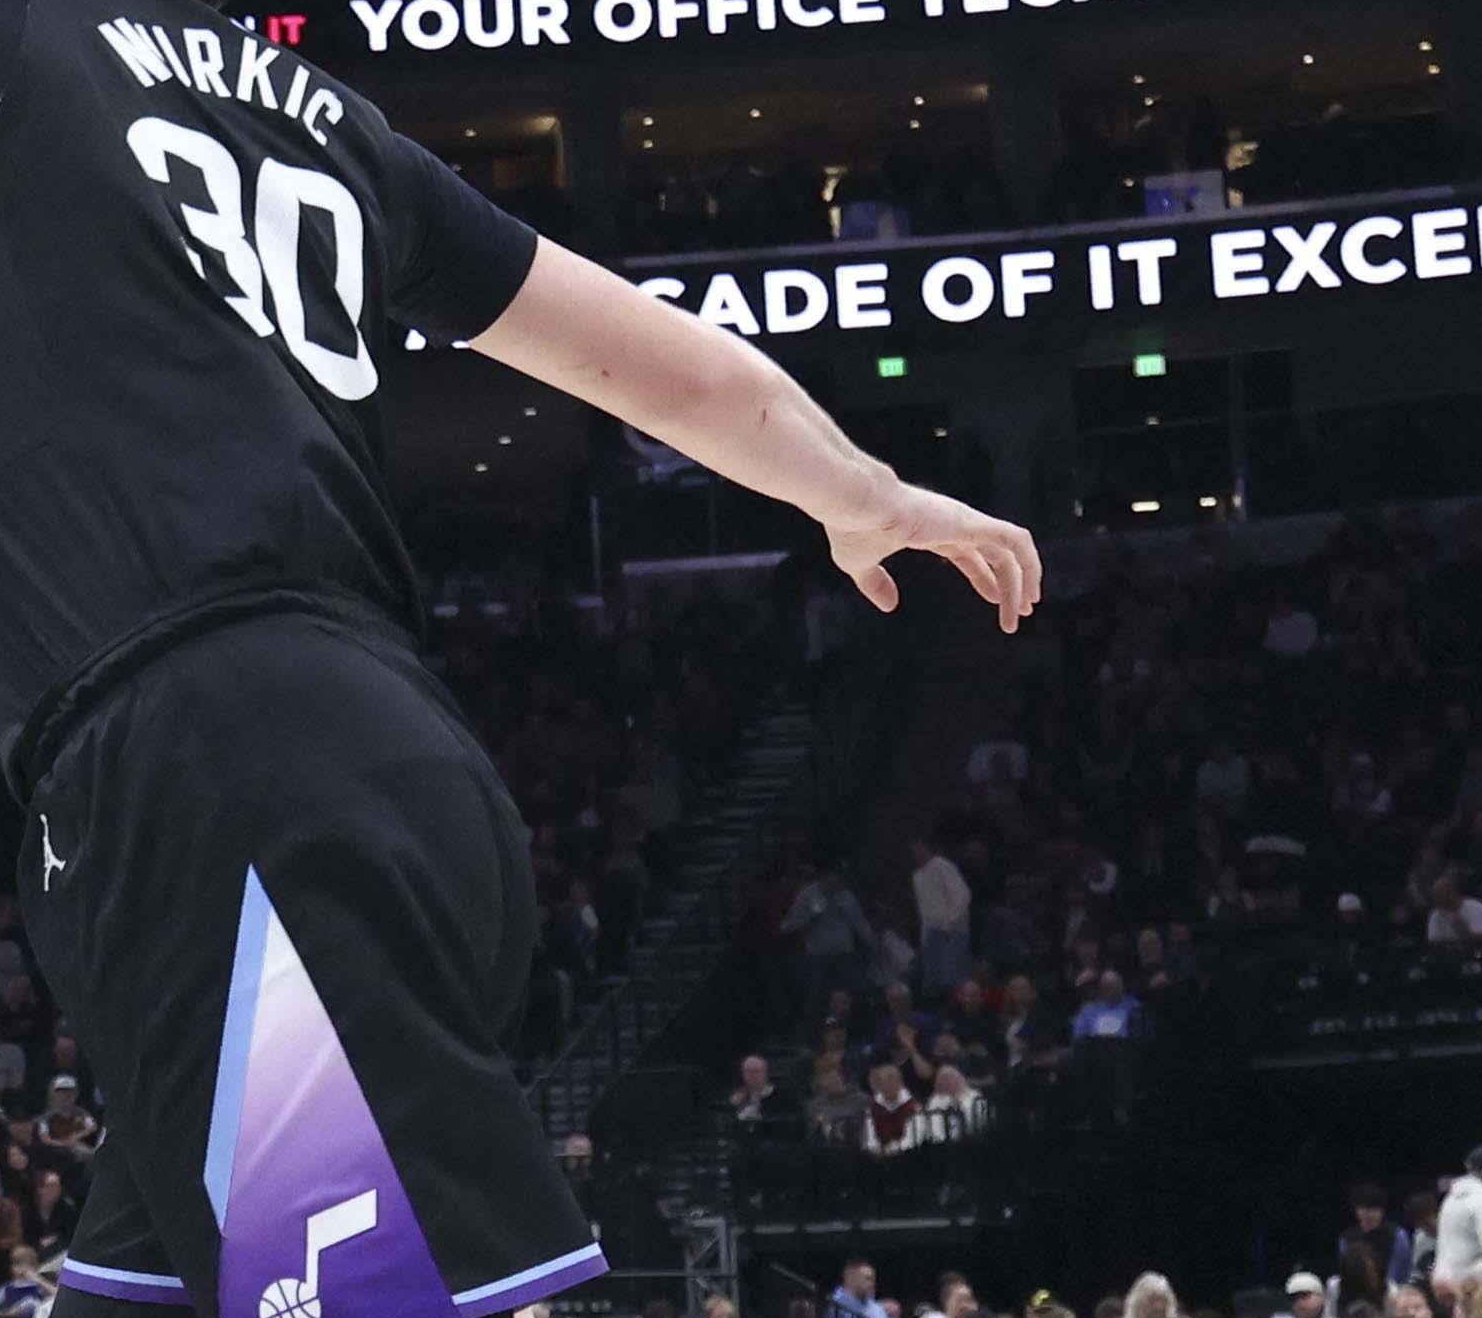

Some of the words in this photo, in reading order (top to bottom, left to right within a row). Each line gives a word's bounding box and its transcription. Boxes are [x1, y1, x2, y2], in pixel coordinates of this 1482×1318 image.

[267, 15, 306, 45] IT
[126, 115, 380, 403] 30
[922, 251, 1055, 323] OF
[1088, 238, 1177, 310] IT
